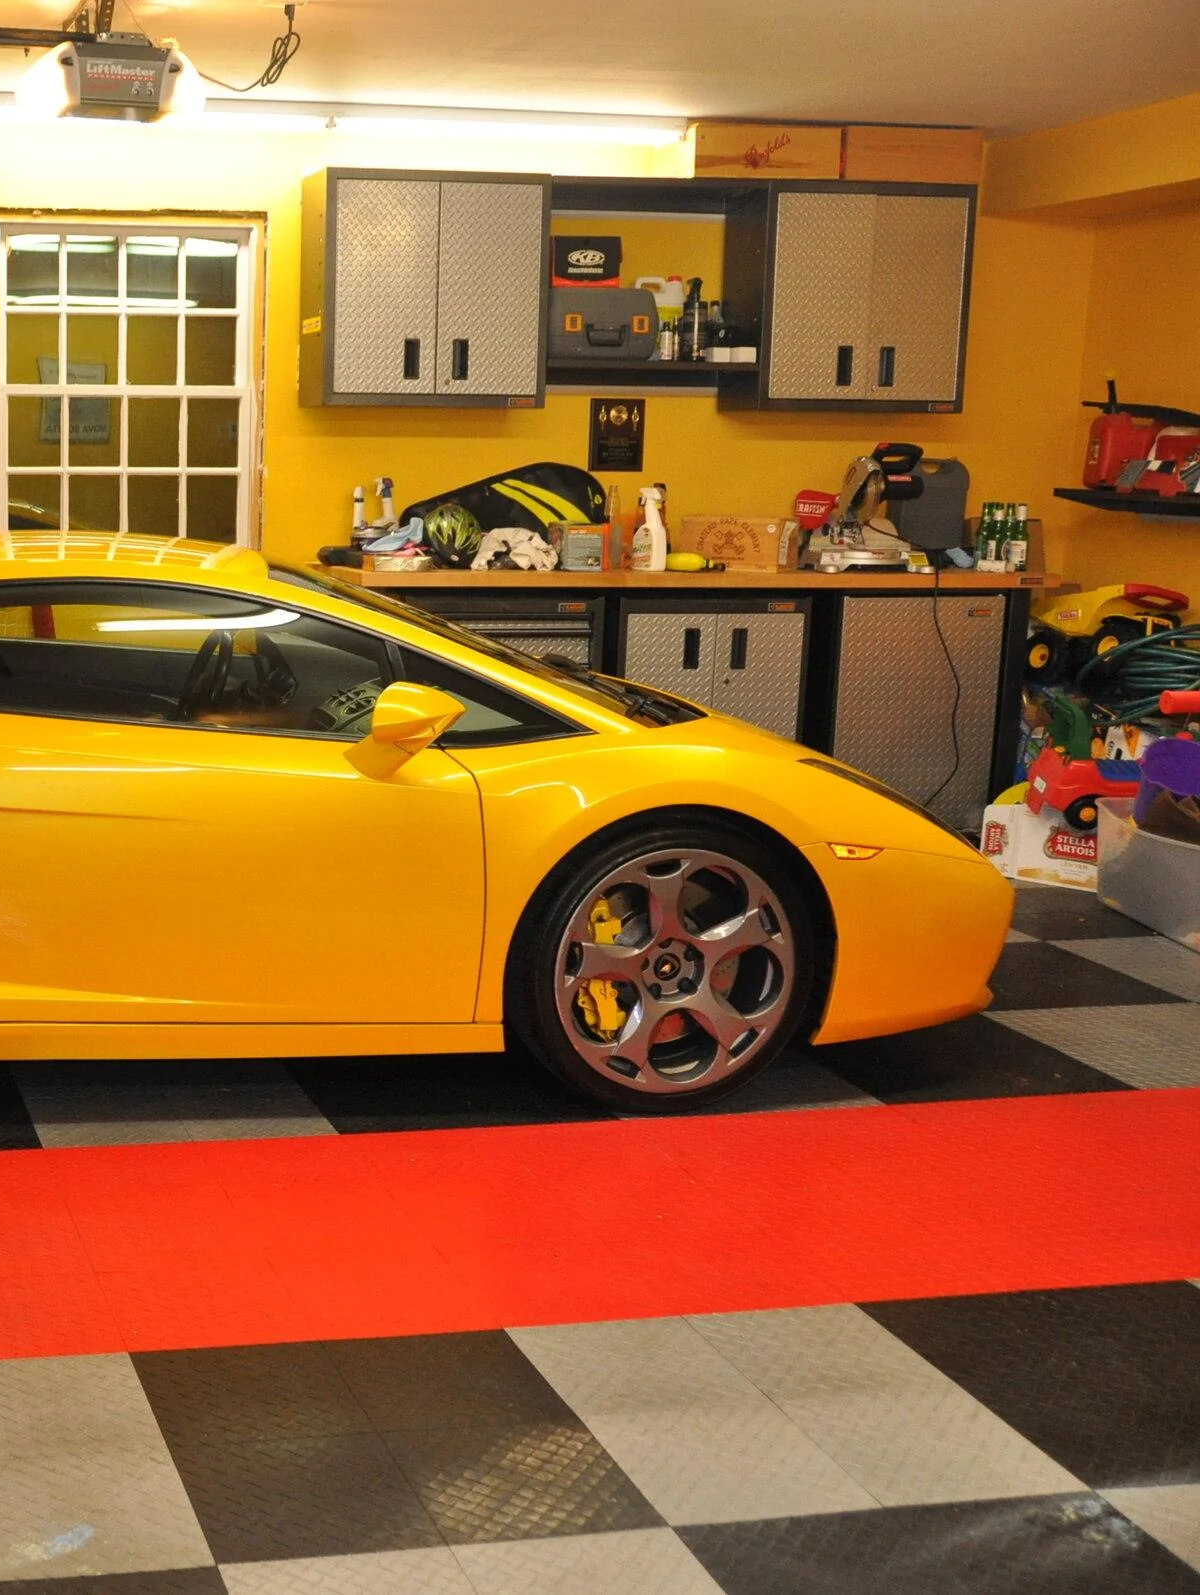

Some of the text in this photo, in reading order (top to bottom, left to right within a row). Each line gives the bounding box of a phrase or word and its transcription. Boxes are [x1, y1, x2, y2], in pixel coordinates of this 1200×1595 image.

[86, 62, 156, 77] LiftMaster
[1056, 834, 1096, 848] STELLA
[1055, 844, 1096, 857] ARTOIS
